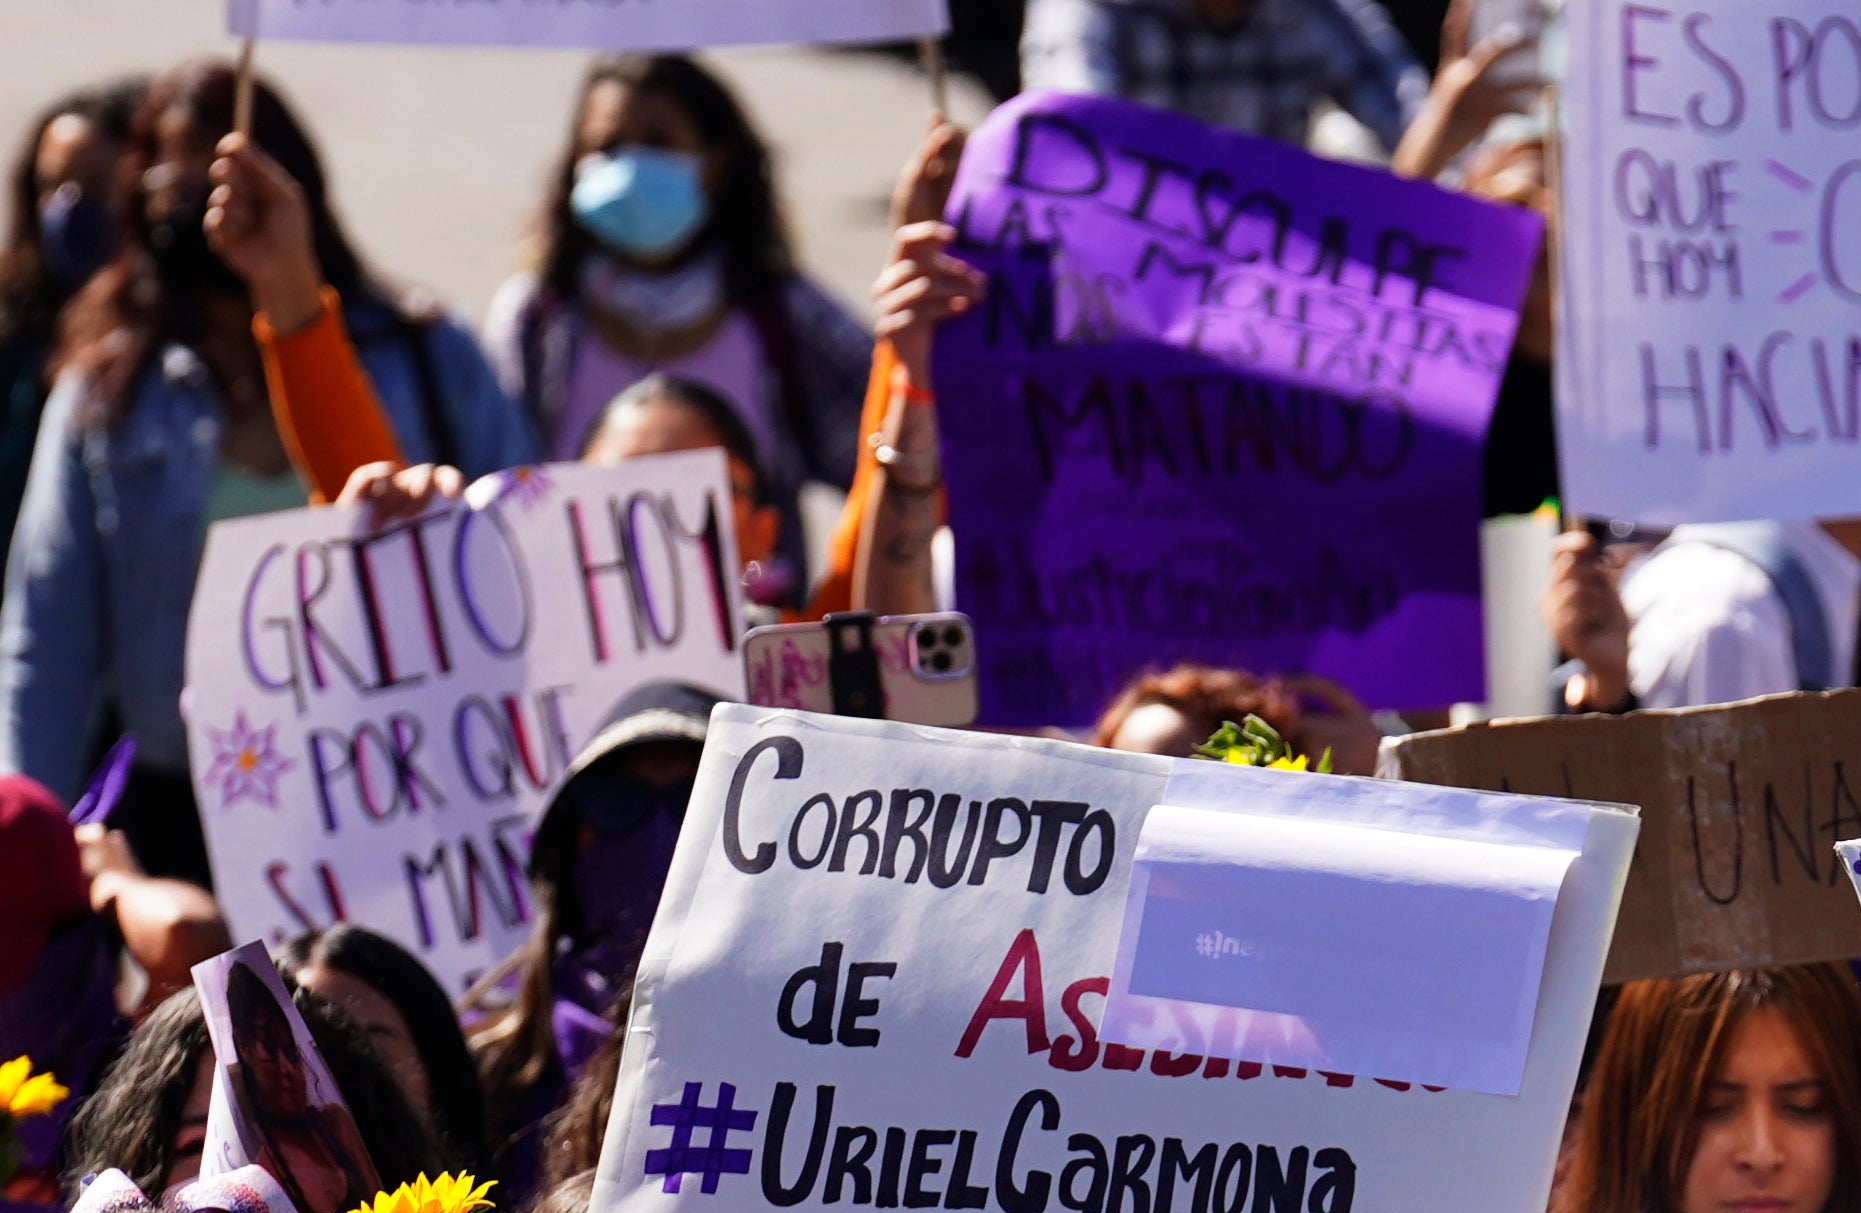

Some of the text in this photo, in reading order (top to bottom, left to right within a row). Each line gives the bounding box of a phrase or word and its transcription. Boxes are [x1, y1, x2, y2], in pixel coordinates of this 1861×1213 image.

[1621, 5, 1746, 135] ES
[1614, 148, 1739, 236] QUE
[1630, 236, 1745, 301] HOY
[243, 490, 737, 712] GRITO HOY
[311, 712, 445, 832] POR
[723, 735, 1115, 895] CORRUPTO
